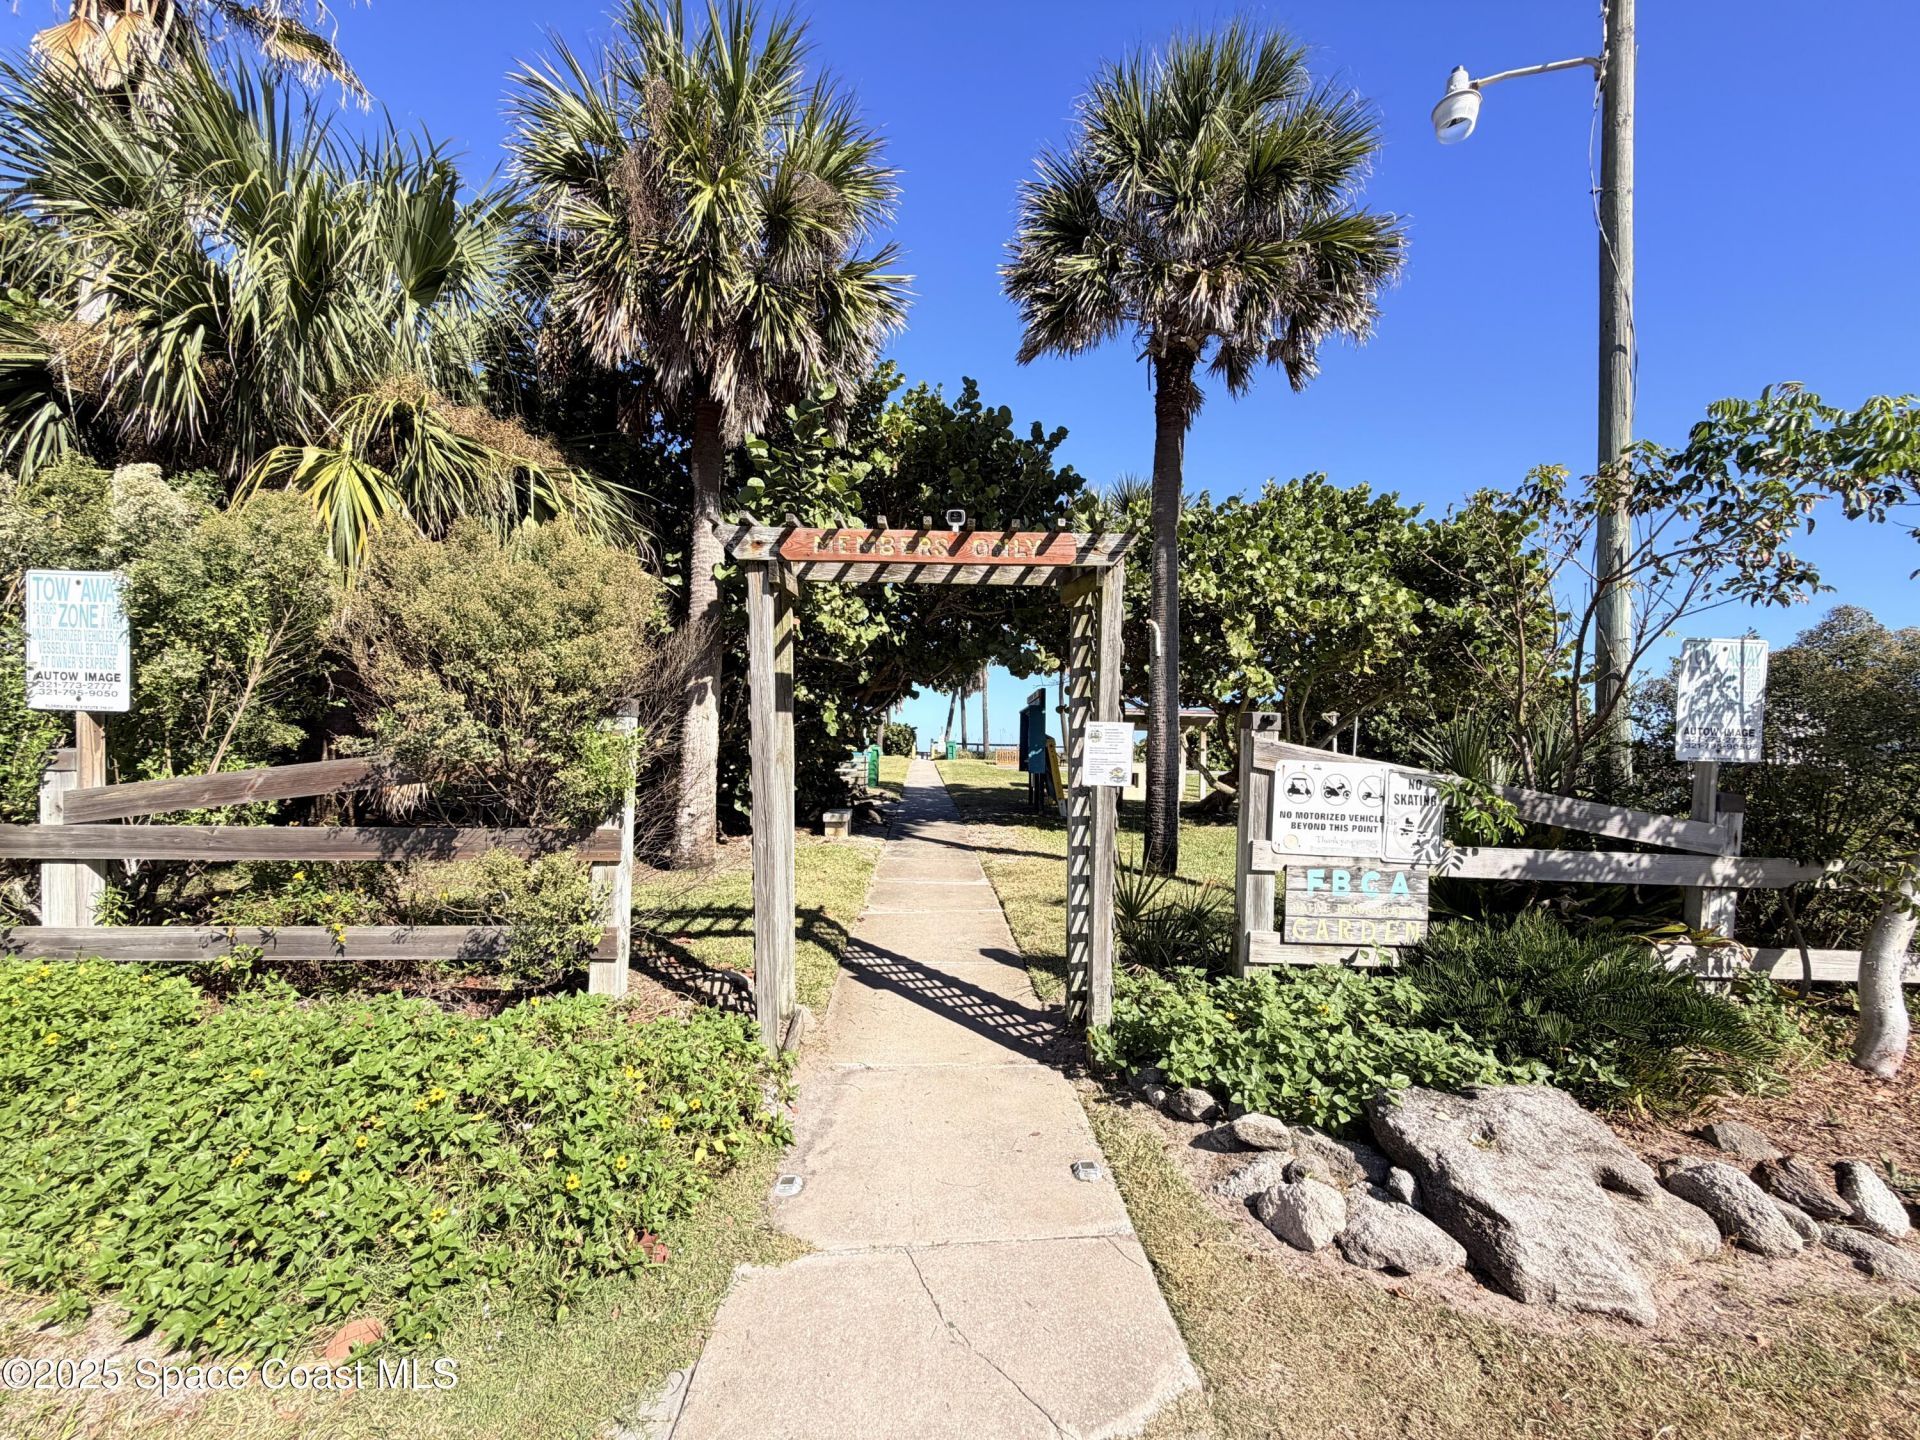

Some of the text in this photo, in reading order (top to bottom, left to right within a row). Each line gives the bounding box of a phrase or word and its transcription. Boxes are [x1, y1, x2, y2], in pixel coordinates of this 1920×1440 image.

[813, 535, 1043, 558] MEMBERS ONLY
[32, 576, 115, 602] TOW AWA
[58, 604, 98, 628] ZONE
[32, 628, 82, 643] UNAUTHORIZED
[83, 630, 114, 643] VEHICLES
[38, 642, 118, 657] VESSELS WILL BE TOWED
[41, 656, 117, 670] AT OWNER'S EXPENSE
[36, 671, 121, 682] AUTOW IMAGE
[39, 682, 113, 690] 321-773-2777
[39, 688, 118, 697] 321-795-9050
[1684, 727, 1755, 738] AUTOW IMAGE
[1394, 779, 1437, 807] NO SKATING
[1279, 811, 1292, 819] NO
[1295, 812, 1346, 821] MOTORIZED
[1349, 814, 1385, 823] VEHICLE
[1290, 822, 1378, 833] BEYOND THIS POINT
[1292, 917, 1421, 944] GARDEN
